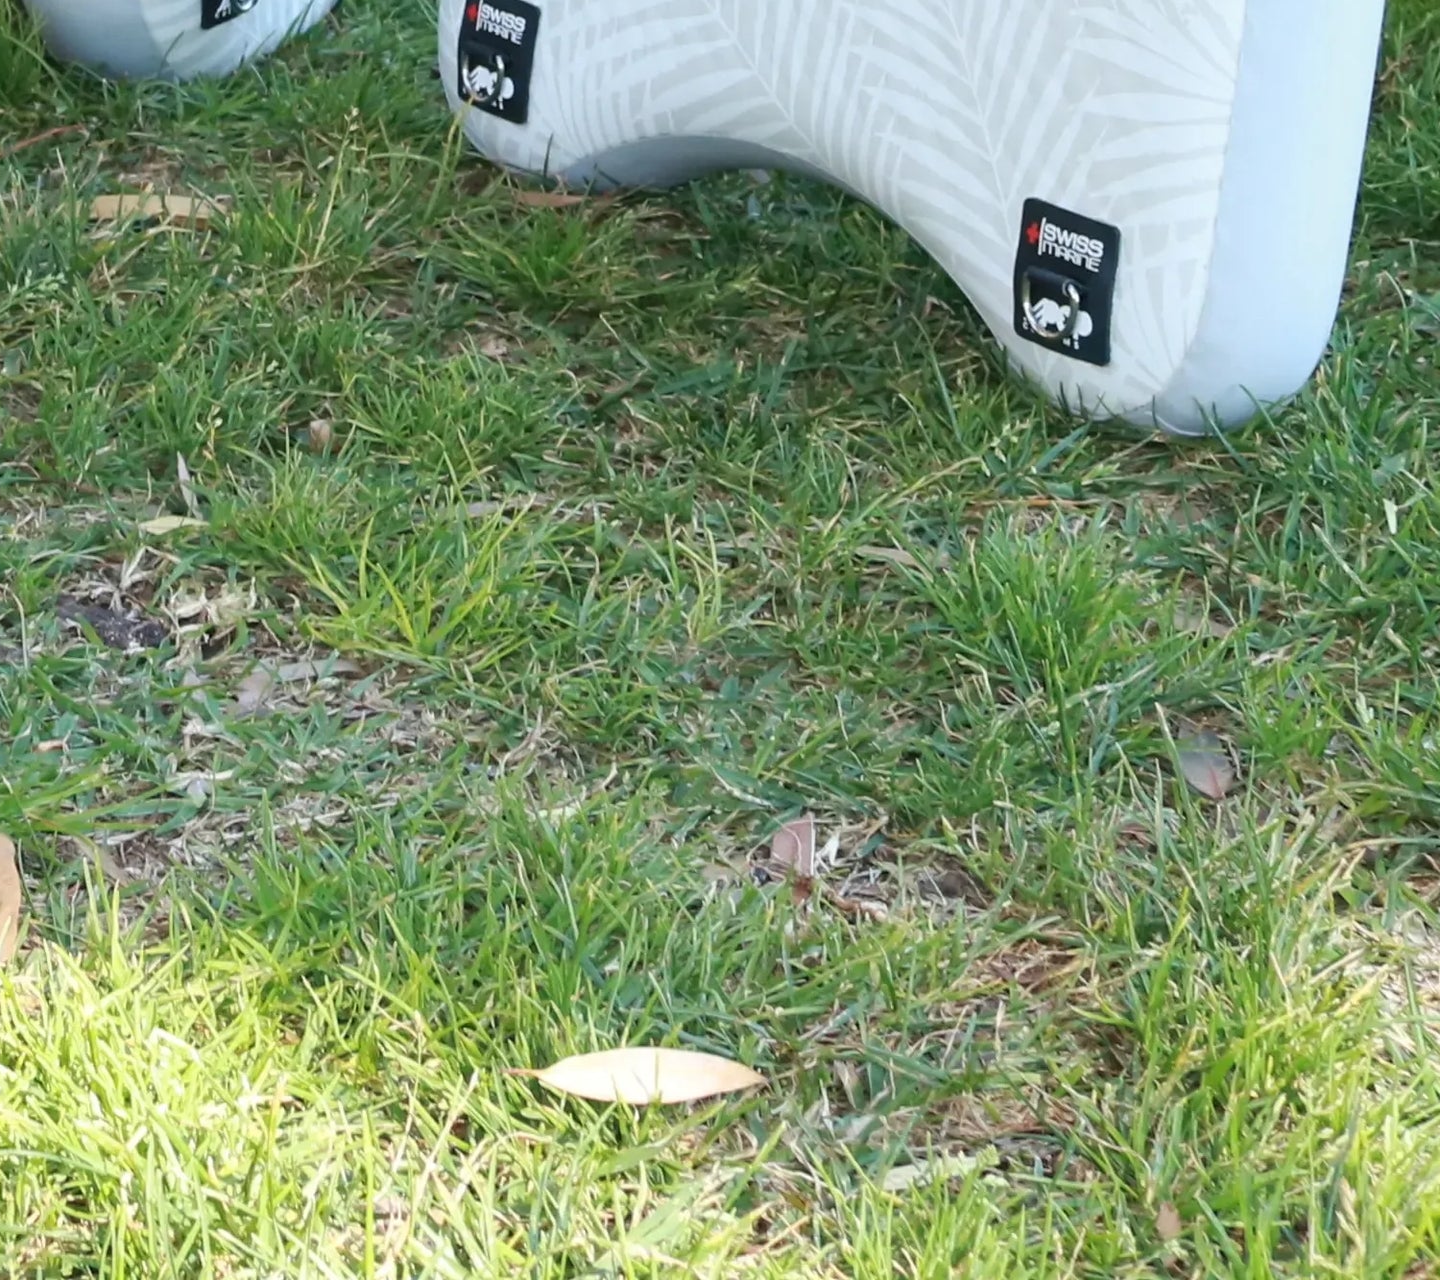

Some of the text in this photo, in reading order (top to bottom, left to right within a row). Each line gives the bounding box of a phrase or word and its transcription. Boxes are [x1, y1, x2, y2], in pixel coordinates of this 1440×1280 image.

[479, 18, 523, 45] MARINE
[480, 3, 526, 32] SWISS
[1044, 222, 1104, 258] SWISS
[1042, 241, 1102, 273] MARINE
